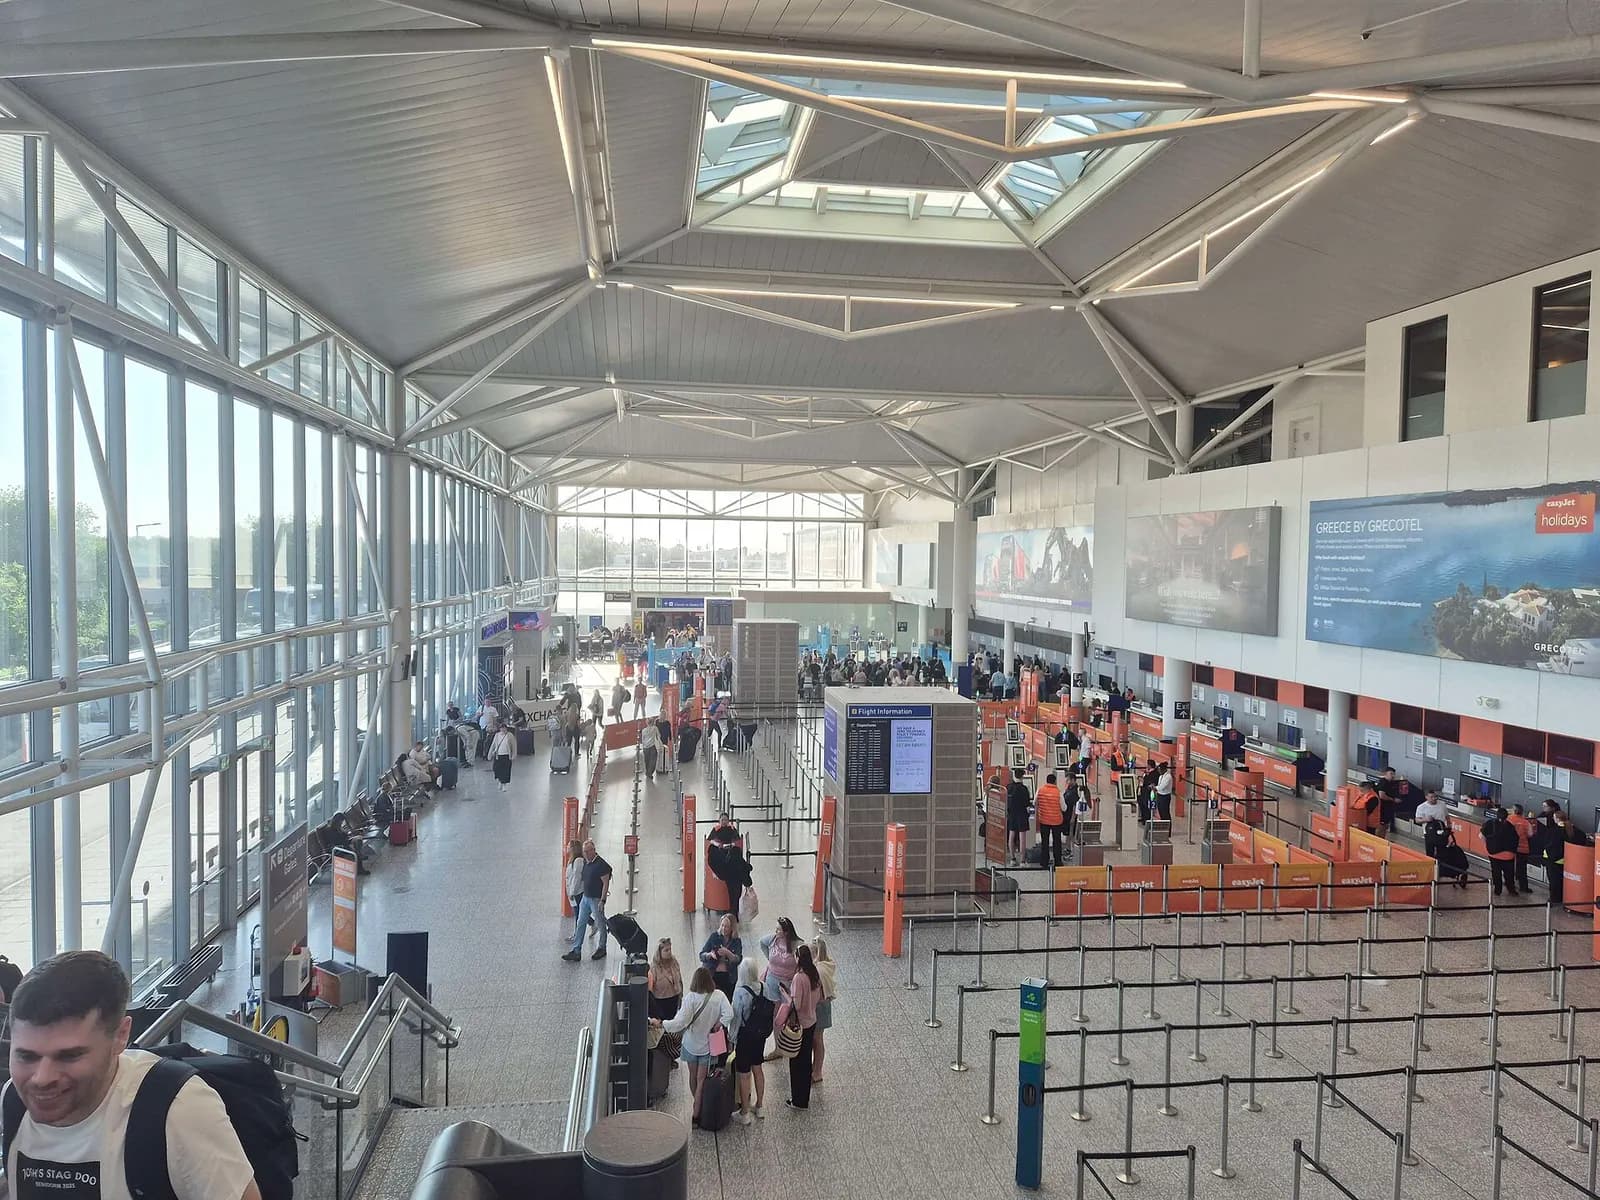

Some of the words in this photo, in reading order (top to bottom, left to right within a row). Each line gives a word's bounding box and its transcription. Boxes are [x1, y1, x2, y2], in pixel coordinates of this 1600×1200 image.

[1546, 498, 1577, 508] easyJet
[1315, 521, 1352, 534] GREECE
[1353, 520, 1367, 533] BY
[1367, 518, 1424, 533] GRECOTEL
[1541, 513, 1588, 529] holidays
[858, 708, 877, 716] Flight
[822, 823, 831, 836] EXIT
[1119, 879, 1154, 889] easyJet
[1231, 876, 1265, 887] easyJet
[1341, 875, 1373, 886] easyJet
[46, 1169, 72, 1180] STAG
[75, 1171, 97, 1186] DOO
